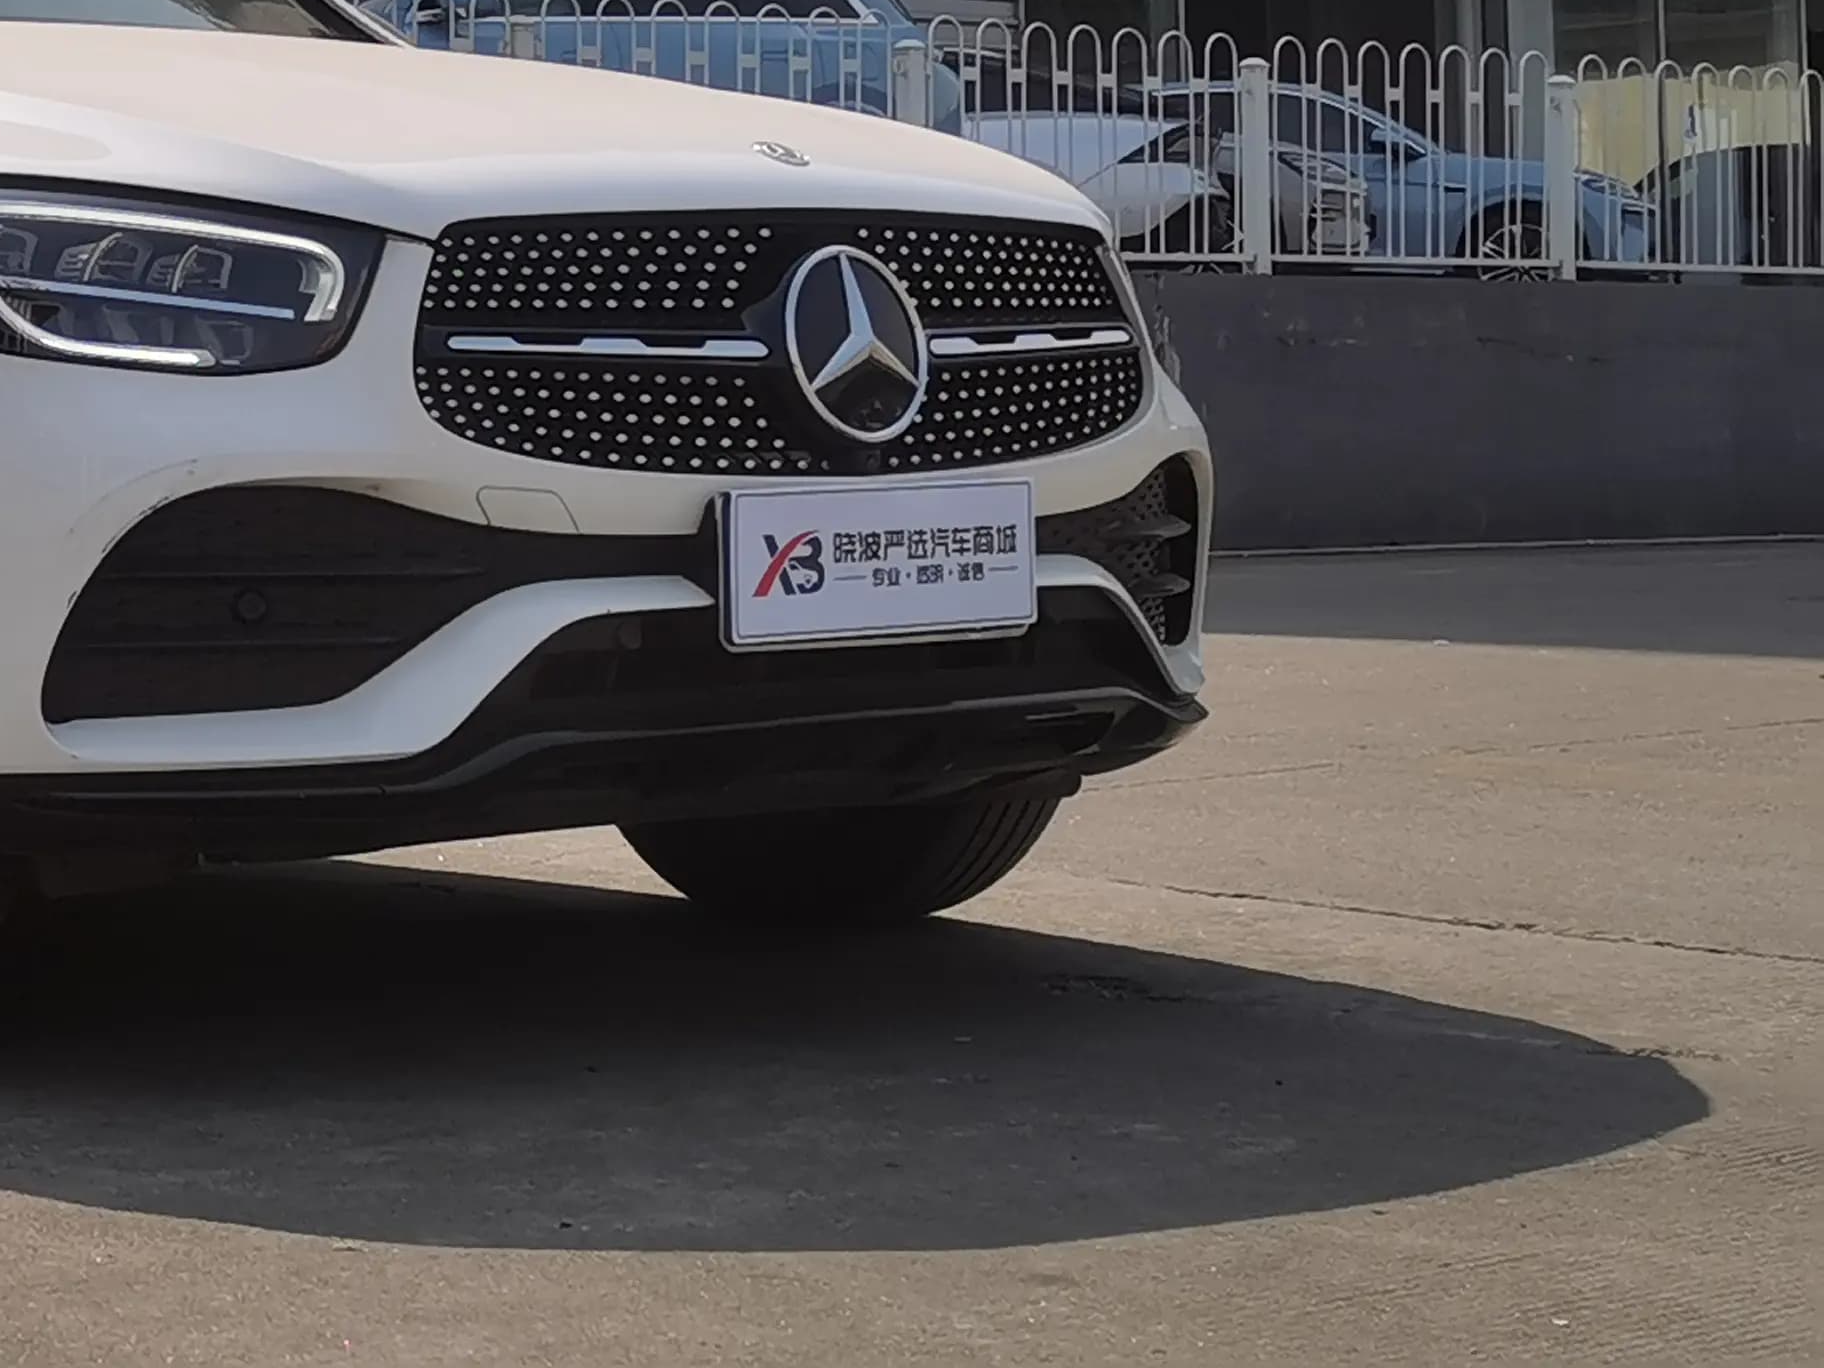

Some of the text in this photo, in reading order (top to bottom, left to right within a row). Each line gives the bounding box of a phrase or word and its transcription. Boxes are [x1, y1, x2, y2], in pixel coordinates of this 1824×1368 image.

[832, 523, 1018, 564] 晓波严选汽车商城
